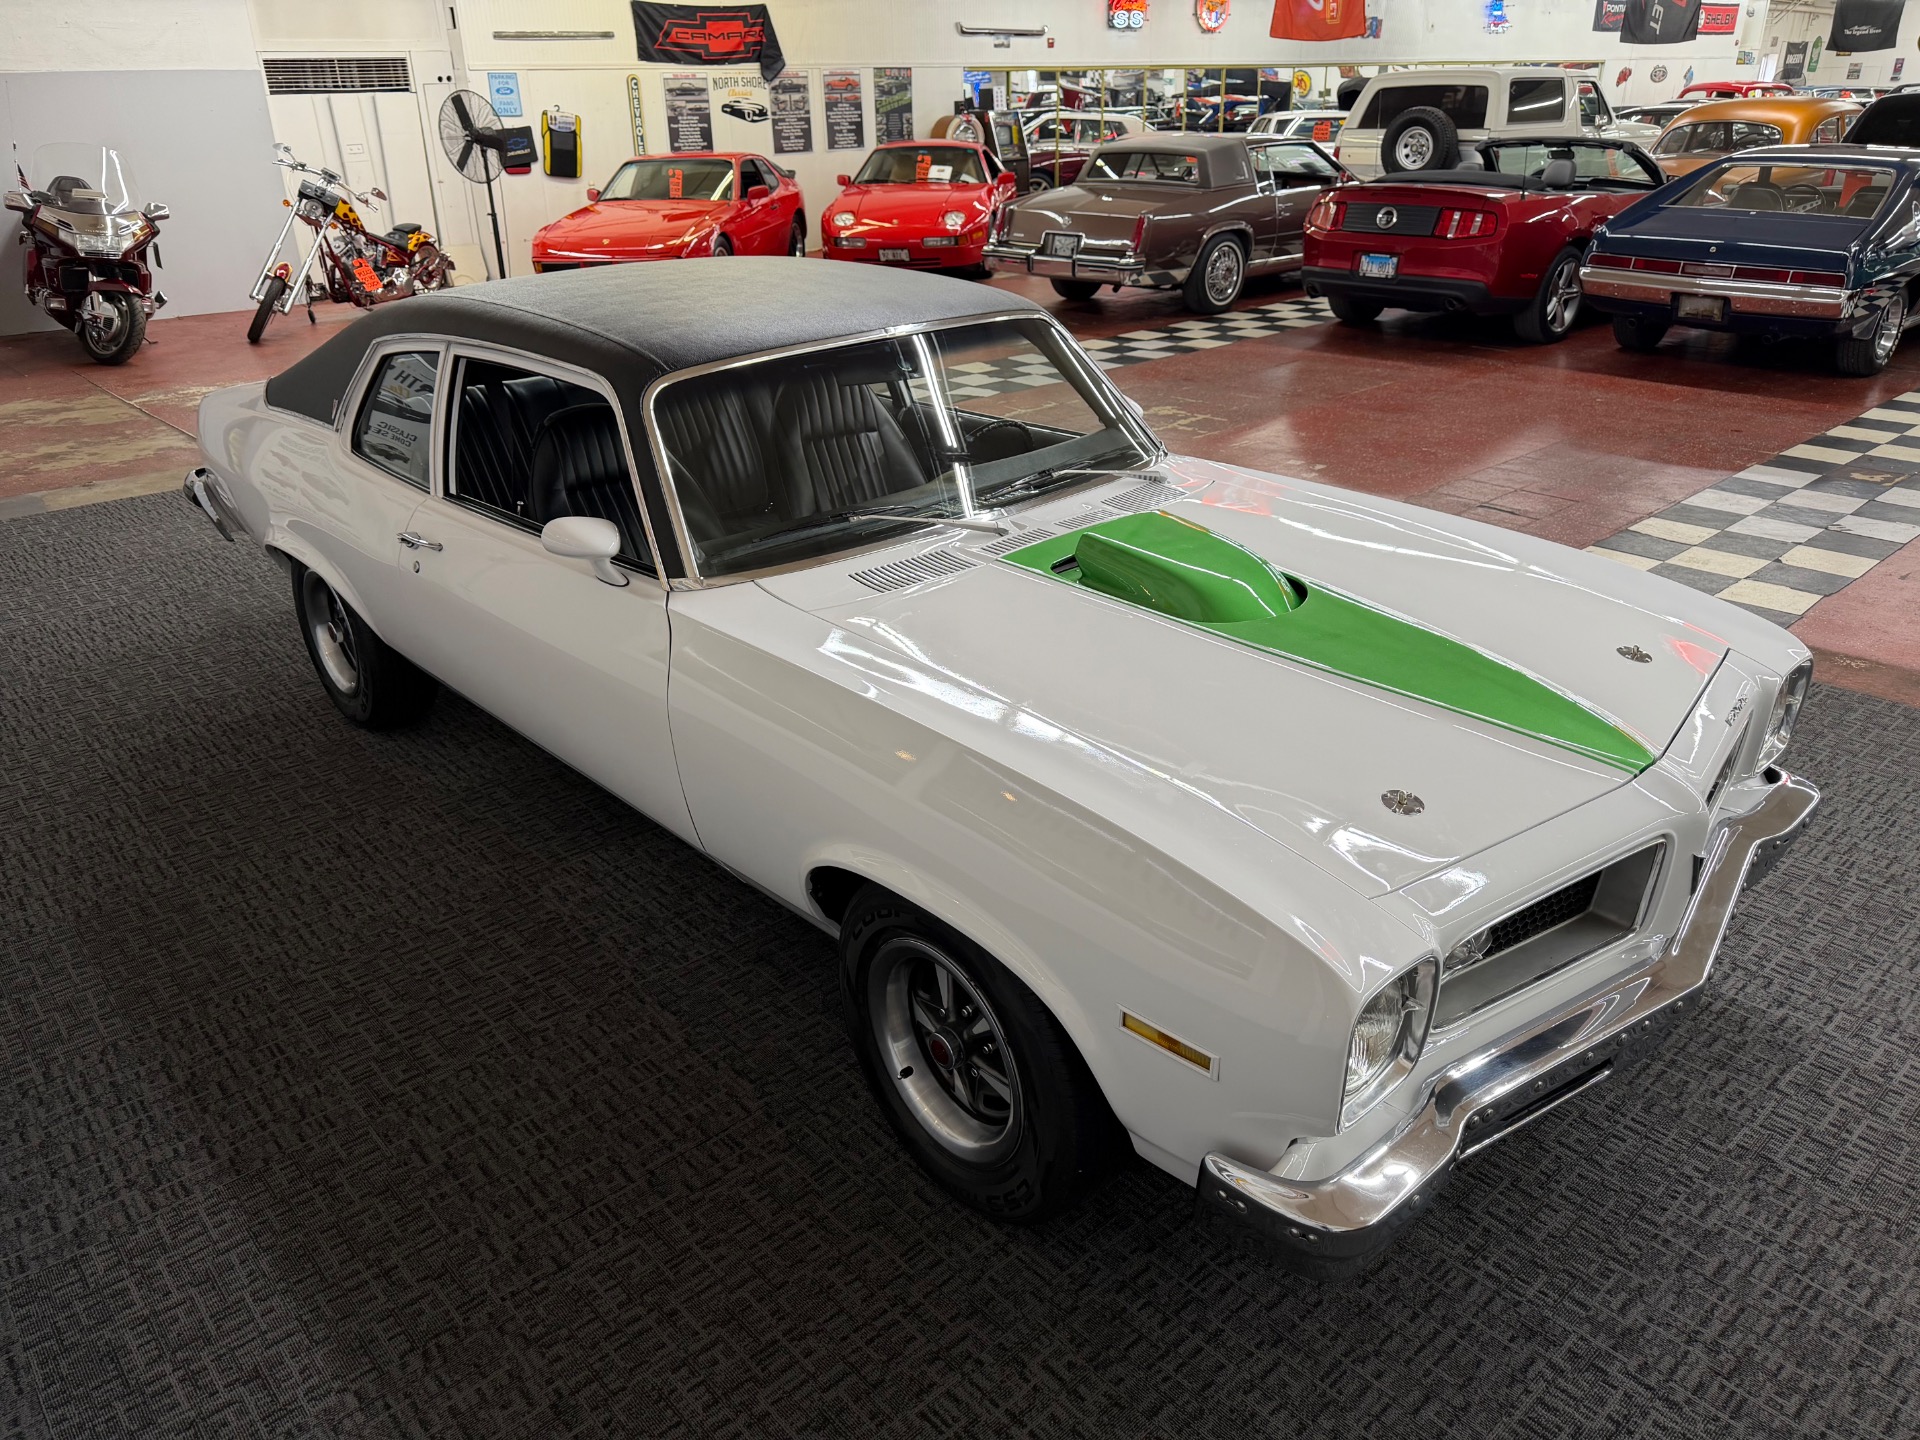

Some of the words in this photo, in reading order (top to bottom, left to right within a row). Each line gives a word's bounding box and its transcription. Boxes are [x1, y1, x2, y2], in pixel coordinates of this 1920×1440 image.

[1112, 10, 1144, 28] SS
[1705, 13, 1735, 25] SHELBY
[712, 76, 740, 91] NORTH
[740, 76, 767, 90] SHORE
[727, 88, 753, 97] Classics
[497, 106, 518, 114] ONLY
[631, 78, 646, 155] CHEVROLE
[507, 148, 532, 157] CHEVROLET
